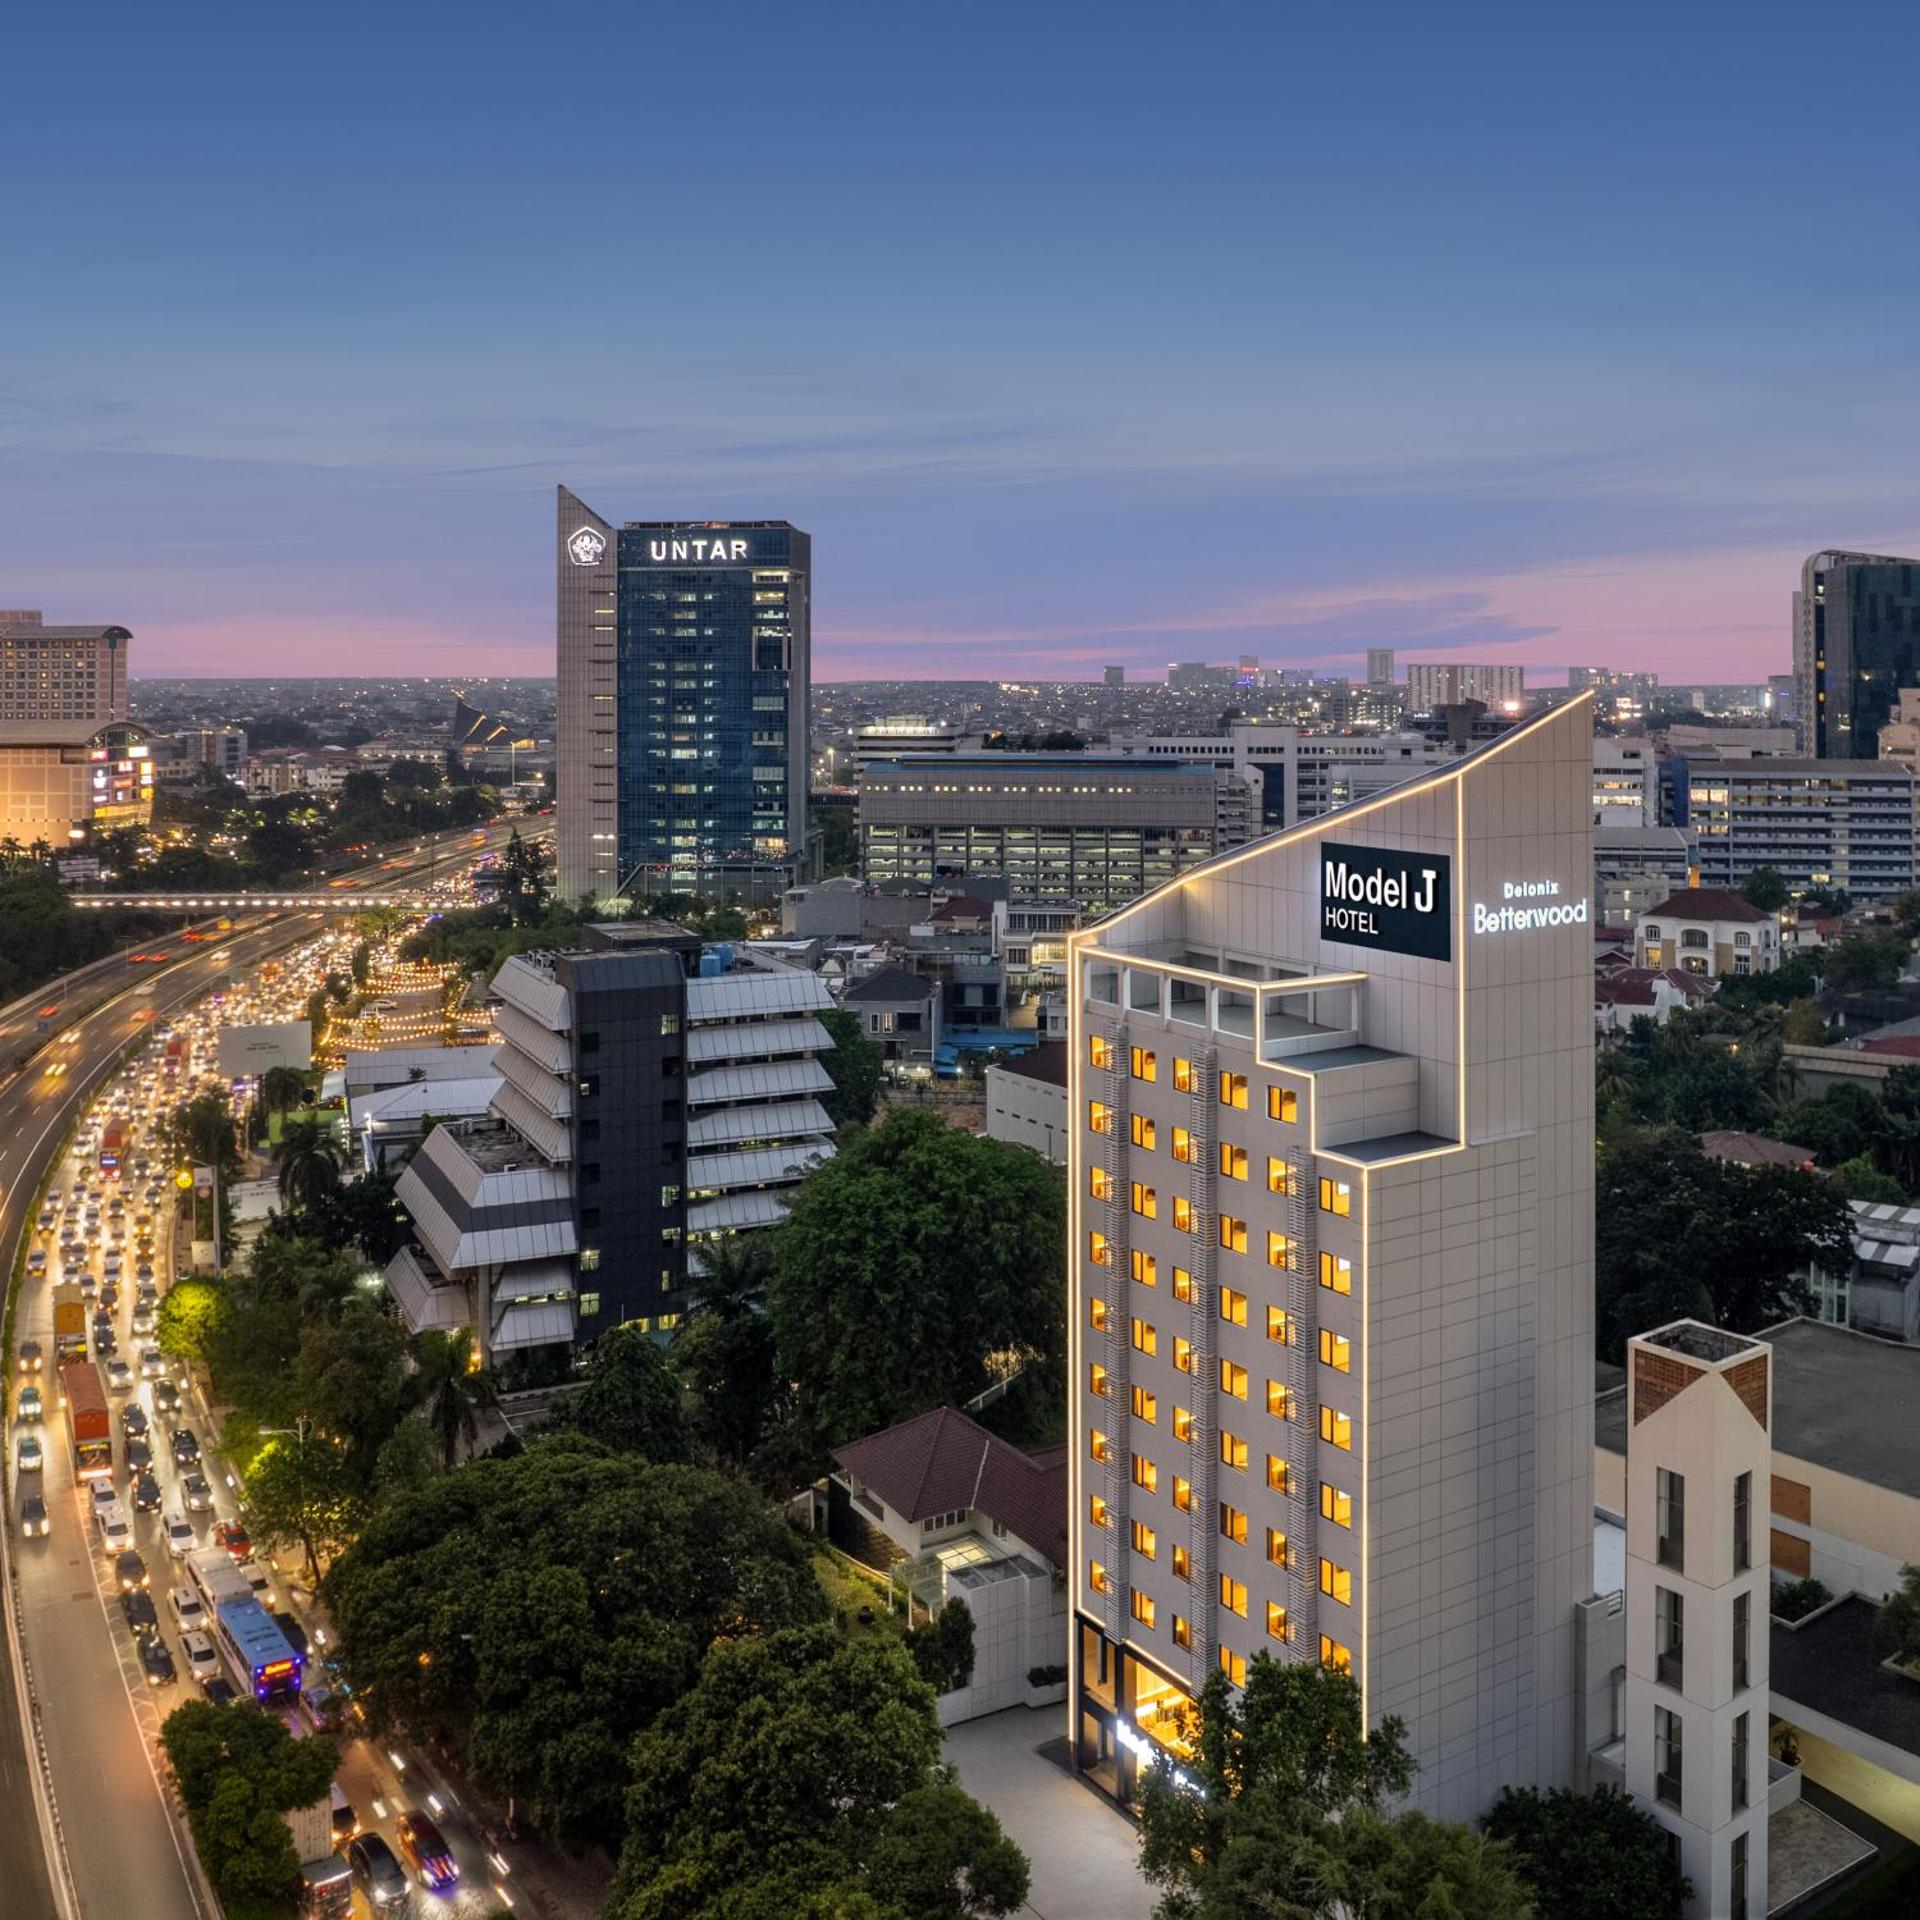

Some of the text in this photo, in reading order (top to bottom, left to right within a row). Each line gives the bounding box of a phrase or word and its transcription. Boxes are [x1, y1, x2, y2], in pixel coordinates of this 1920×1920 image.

[651, 540, 748, 561] UNTAR
[1325, 861, 1436, 913] Model J
[1503, 879, 1560, 899] Delonix
[1325, 907, 1379, 935] HOTEL
[1473, 898, 1587, 934] Betterwood
